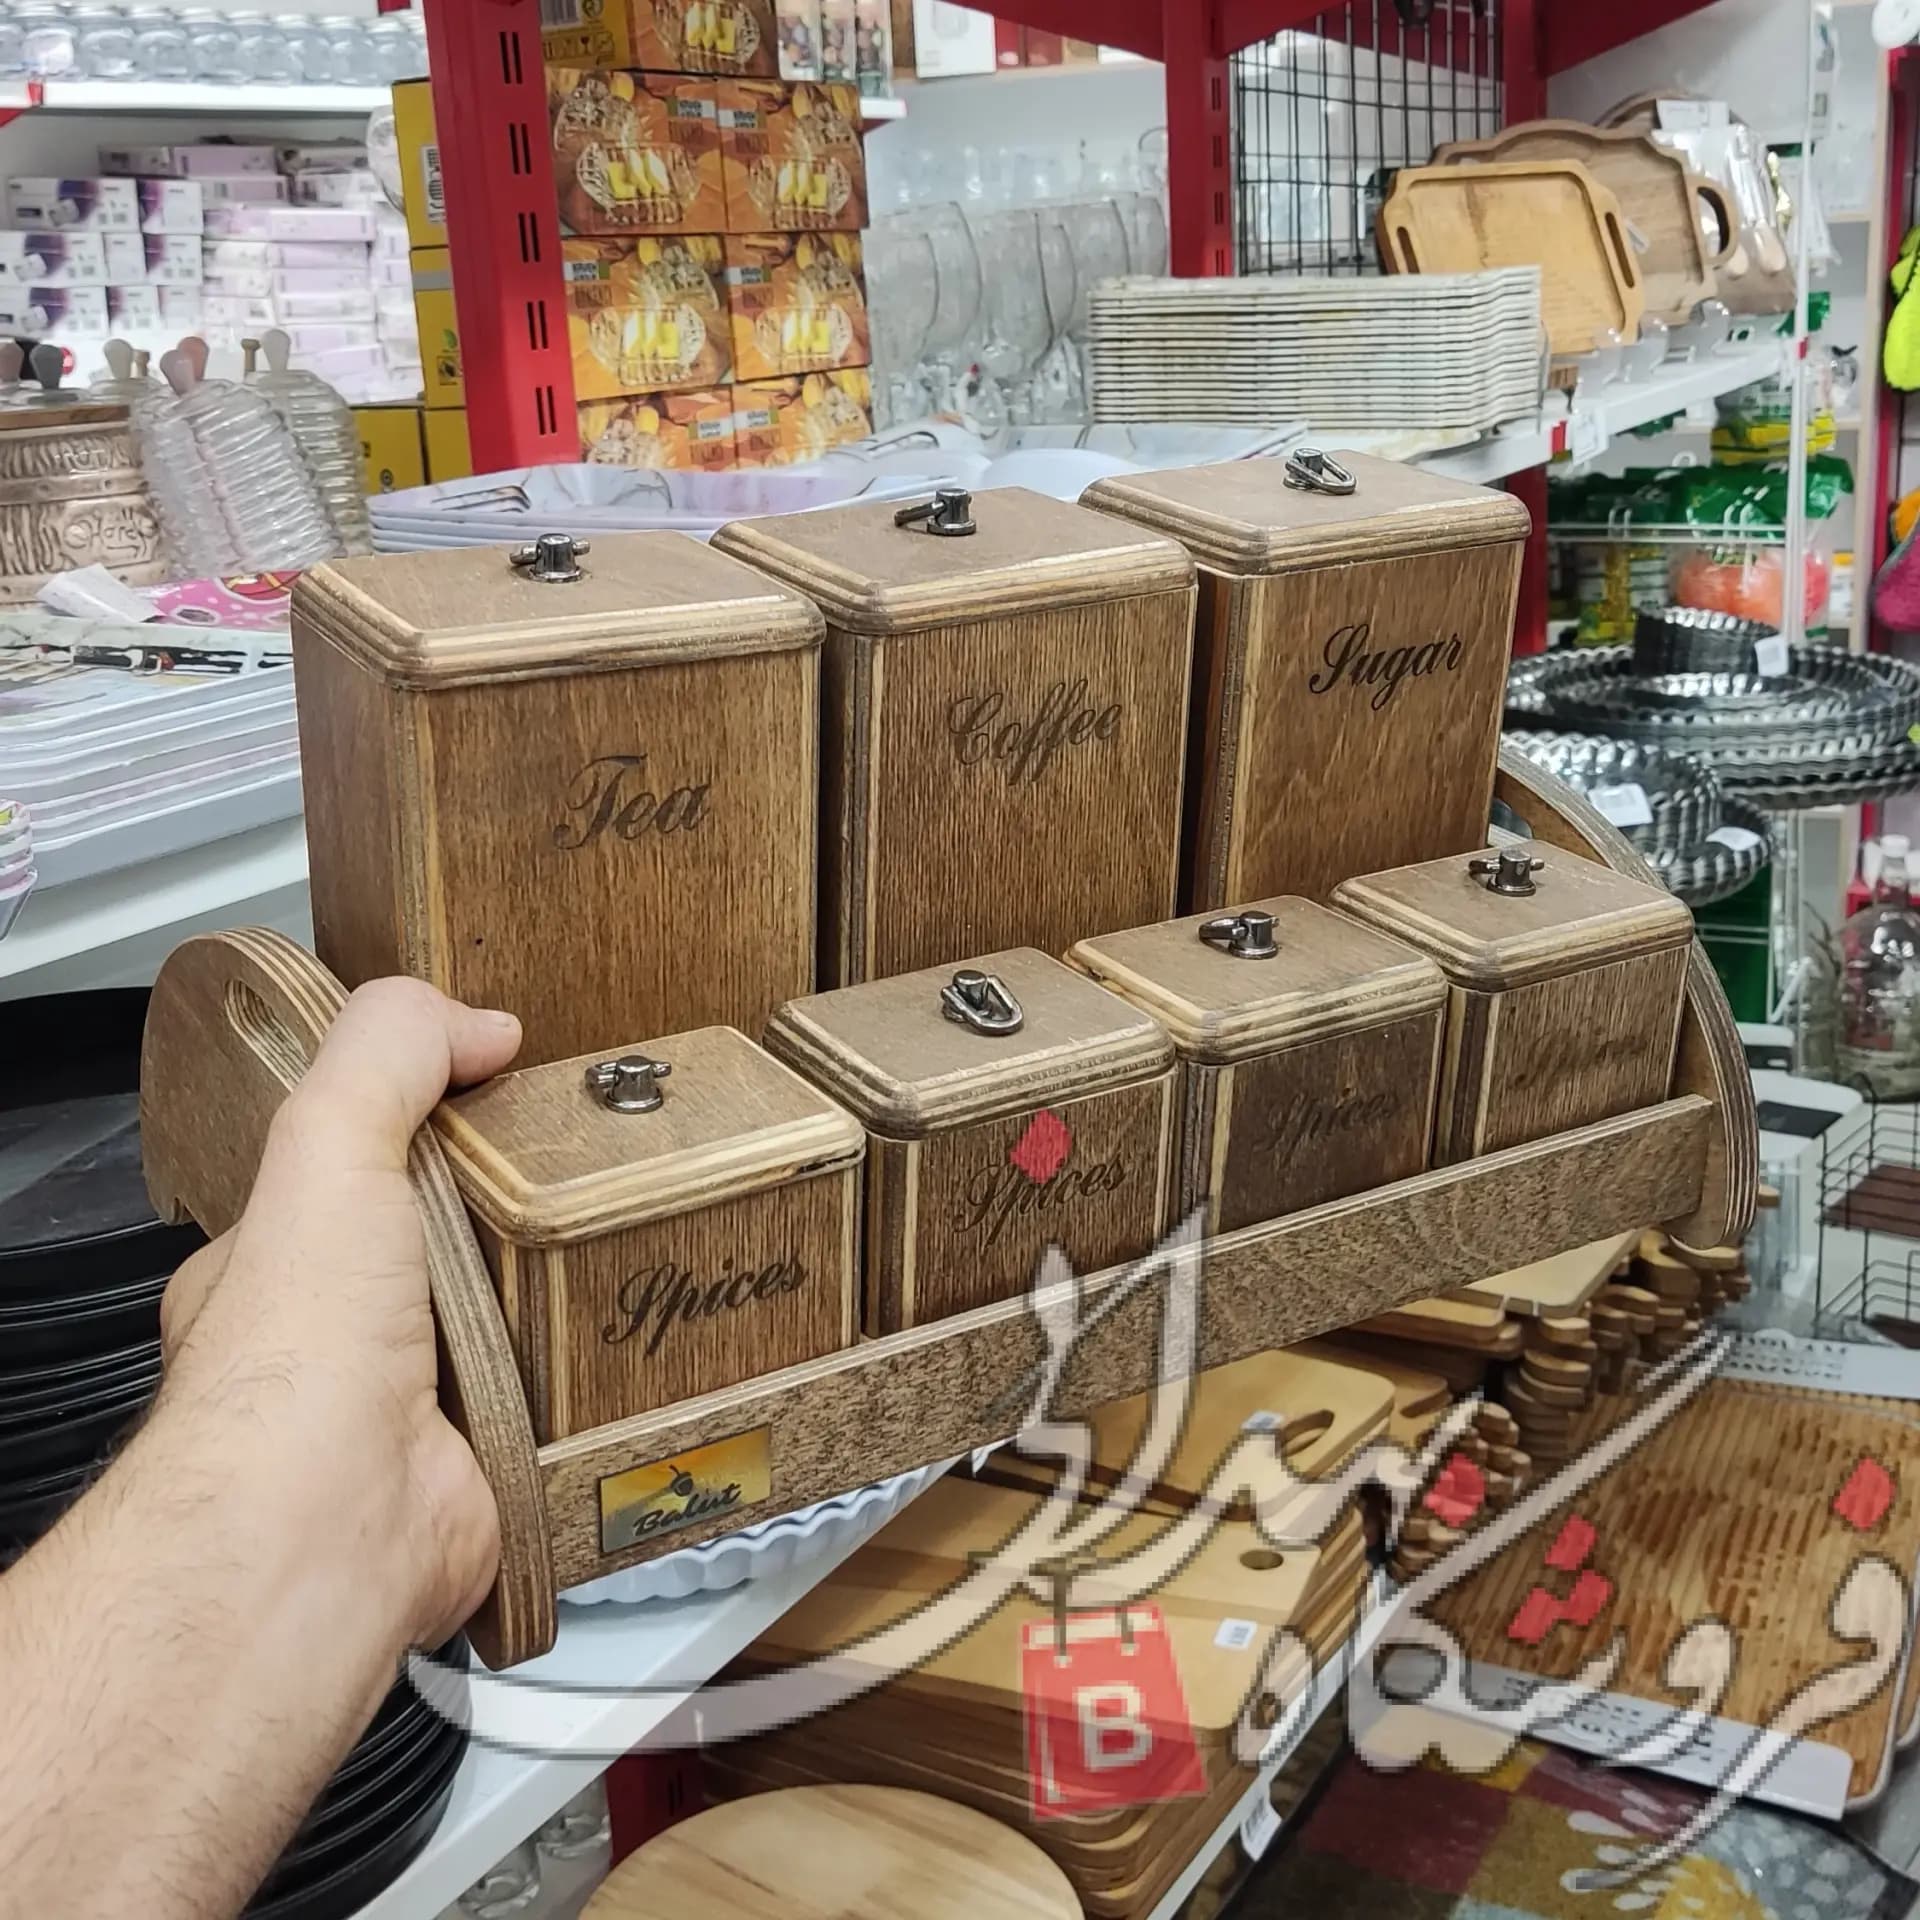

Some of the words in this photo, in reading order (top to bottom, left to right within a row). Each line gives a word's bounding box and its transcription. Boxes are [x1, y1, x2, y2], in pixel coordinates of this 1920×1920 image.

[1309, 623, 1462, 711] Sugar
[946, 678, 1123, 786] Coffee
[552, 752, 712, 850] Tea
[951, 1153, 1128, 1256] Spices
[601, 1257, 810, 1361] Spices
